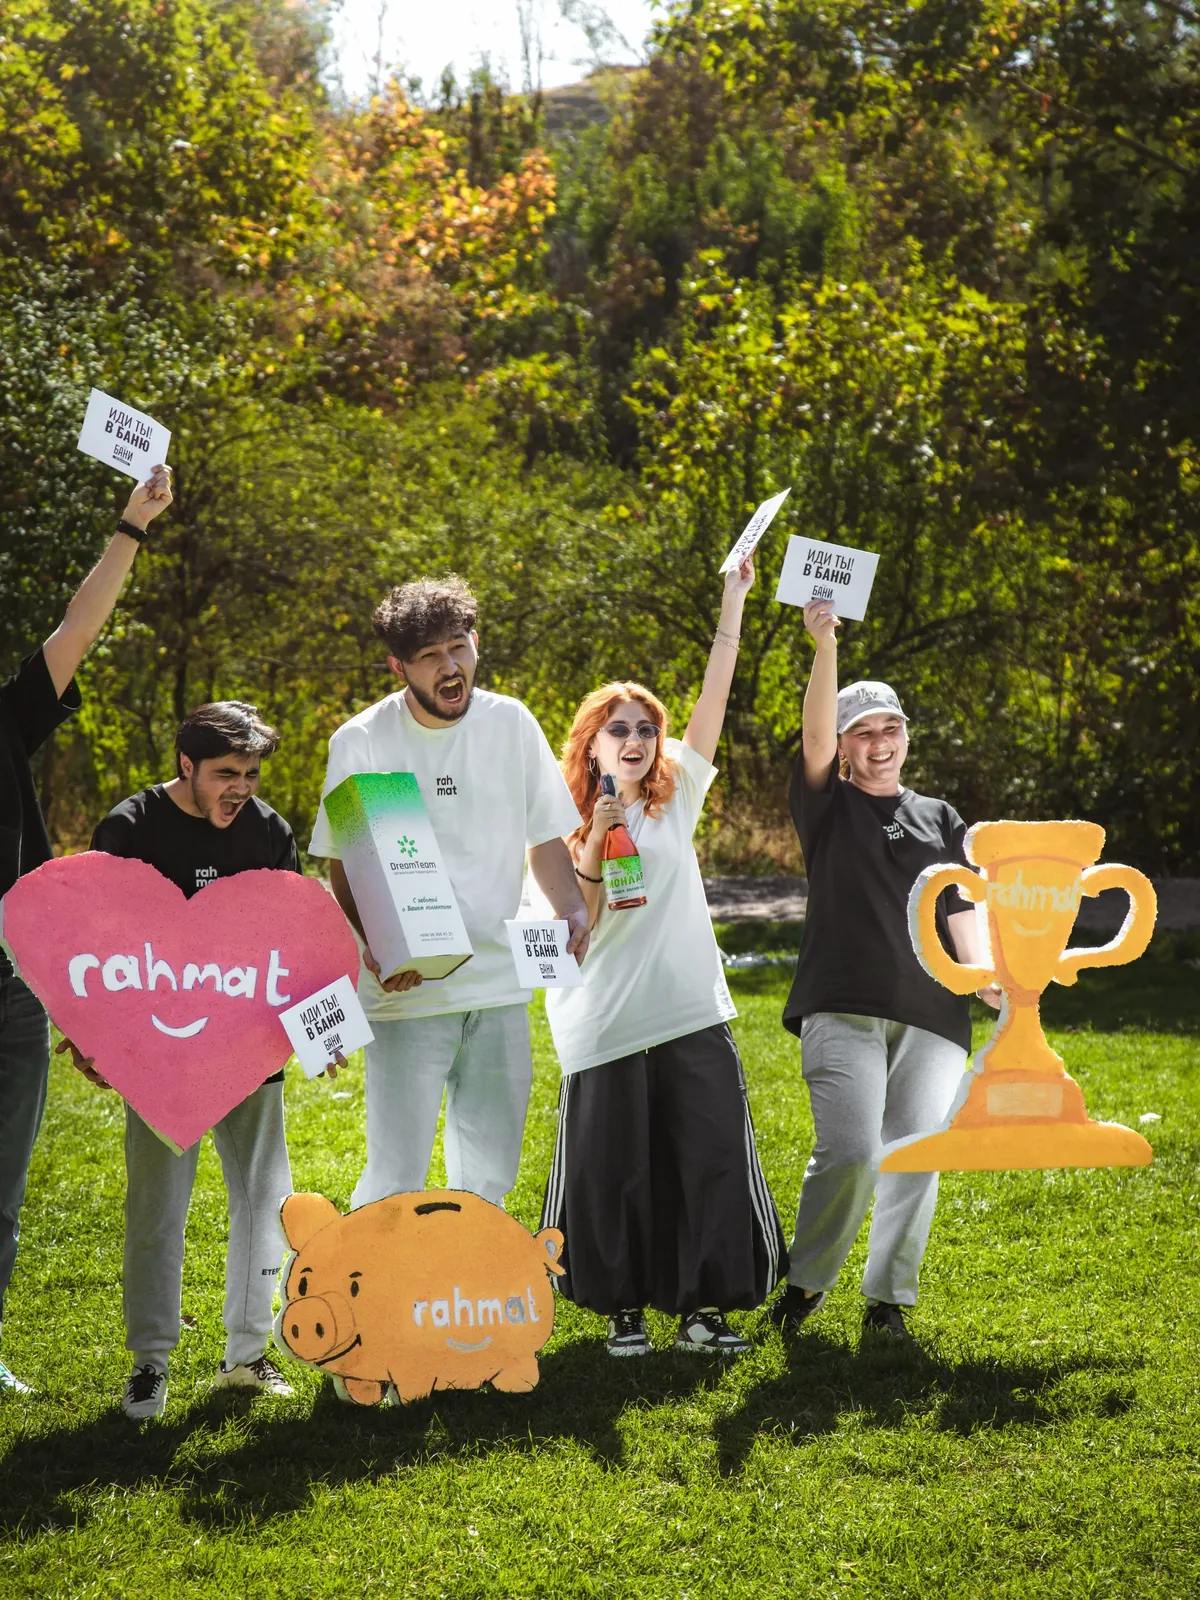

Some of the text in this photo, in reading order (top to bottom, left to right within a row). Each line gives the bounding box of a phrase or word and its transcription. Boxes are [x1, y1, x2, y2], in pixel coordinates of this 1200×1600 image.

[108, 406, 153, 440] ИДИ ТЫ!
[104, 420, 150, 453] В БАНЮ
[113, 444, 134, 462] БАНИ
[806, 548, 855, 572] ИДИ ТЫ!
[802, 563, 852, 586] В БАНЮ
[812, 585, 834, 600] БАНИ
[436, 774, 453, 786] rah
[437, 785, 458, 796] mat
[195, 866, 218, 878] rah
[389, 860, 437, 871] DreamTeam
[522, 928, 556, 944] ИДИ ТЫ!
[525, 944, 559, 958] В БАНЮ
[68, 942, 291, 1007] rahmat
[299, 993, 340, 1027] ИДИ ТЫ!
[305, 1008, 346, 1041] В БАНЮ
[323, 1033, 342, 1051] БАНИ
[412, 1285, 540, 1328] rahmat
